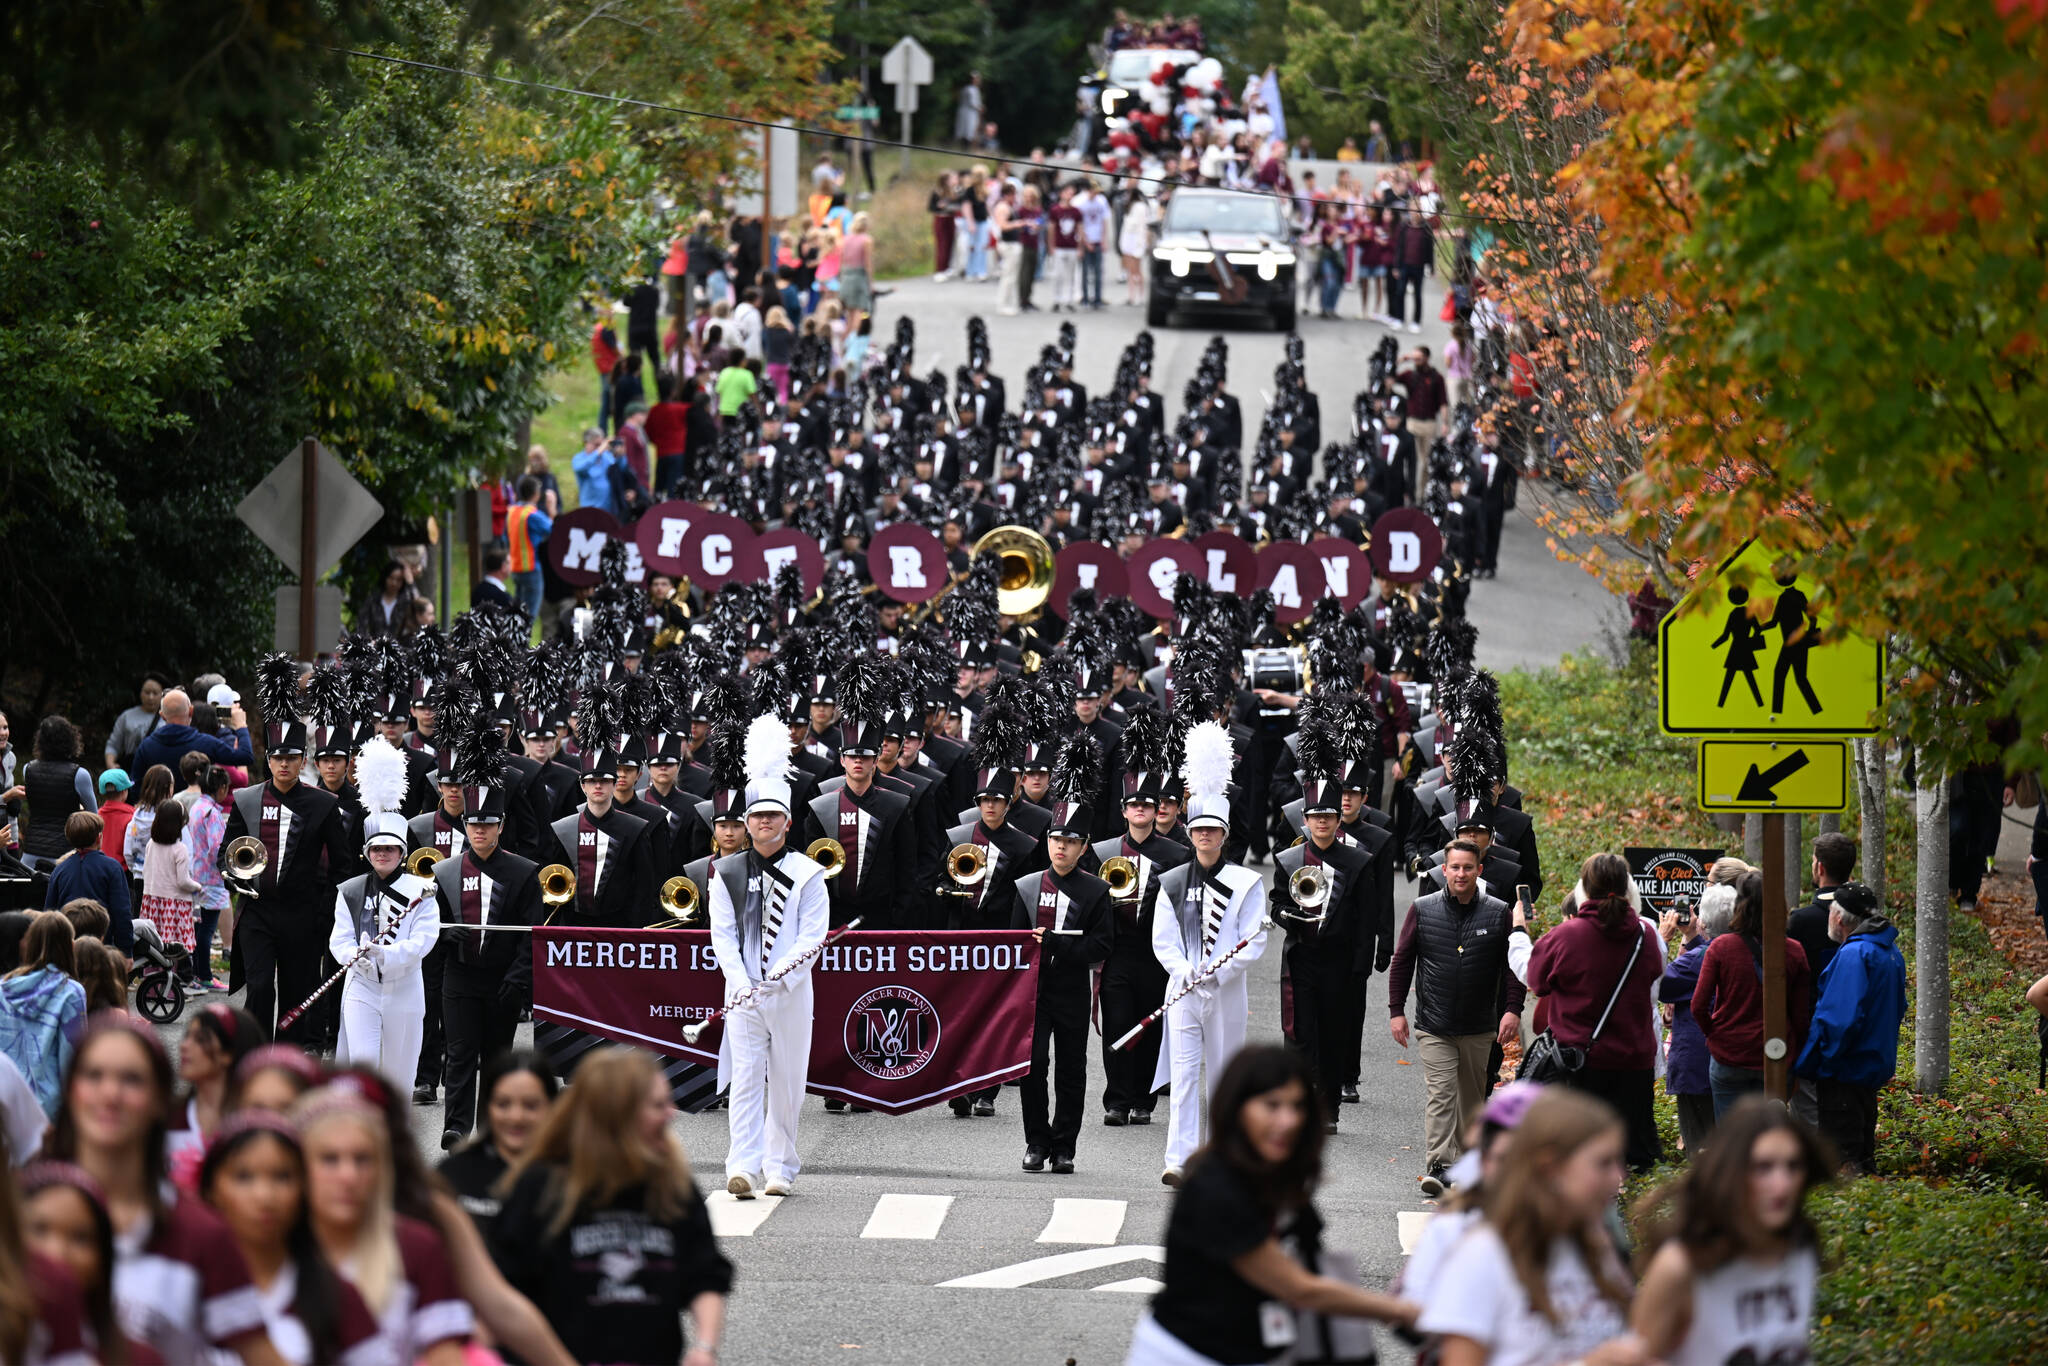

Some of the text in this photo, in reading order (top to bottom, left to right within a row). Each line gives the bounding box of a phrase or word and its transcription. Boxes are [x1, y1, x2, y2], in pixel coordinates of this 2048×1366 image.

[1654, 866, 1694, 880] Re-Elect
[1635, 880, 1707, 895] AKE JACOBSO
[546, 940, 678, 971] MERCER
[820, 944, 1030, 972] HIGH SCHOOL
[649, 1004, 715, 1020] MERCER
[854, 988, 931, 1015] MERCER ISLAND
[852, 1050, 930, 1077] MARCHING BAND
